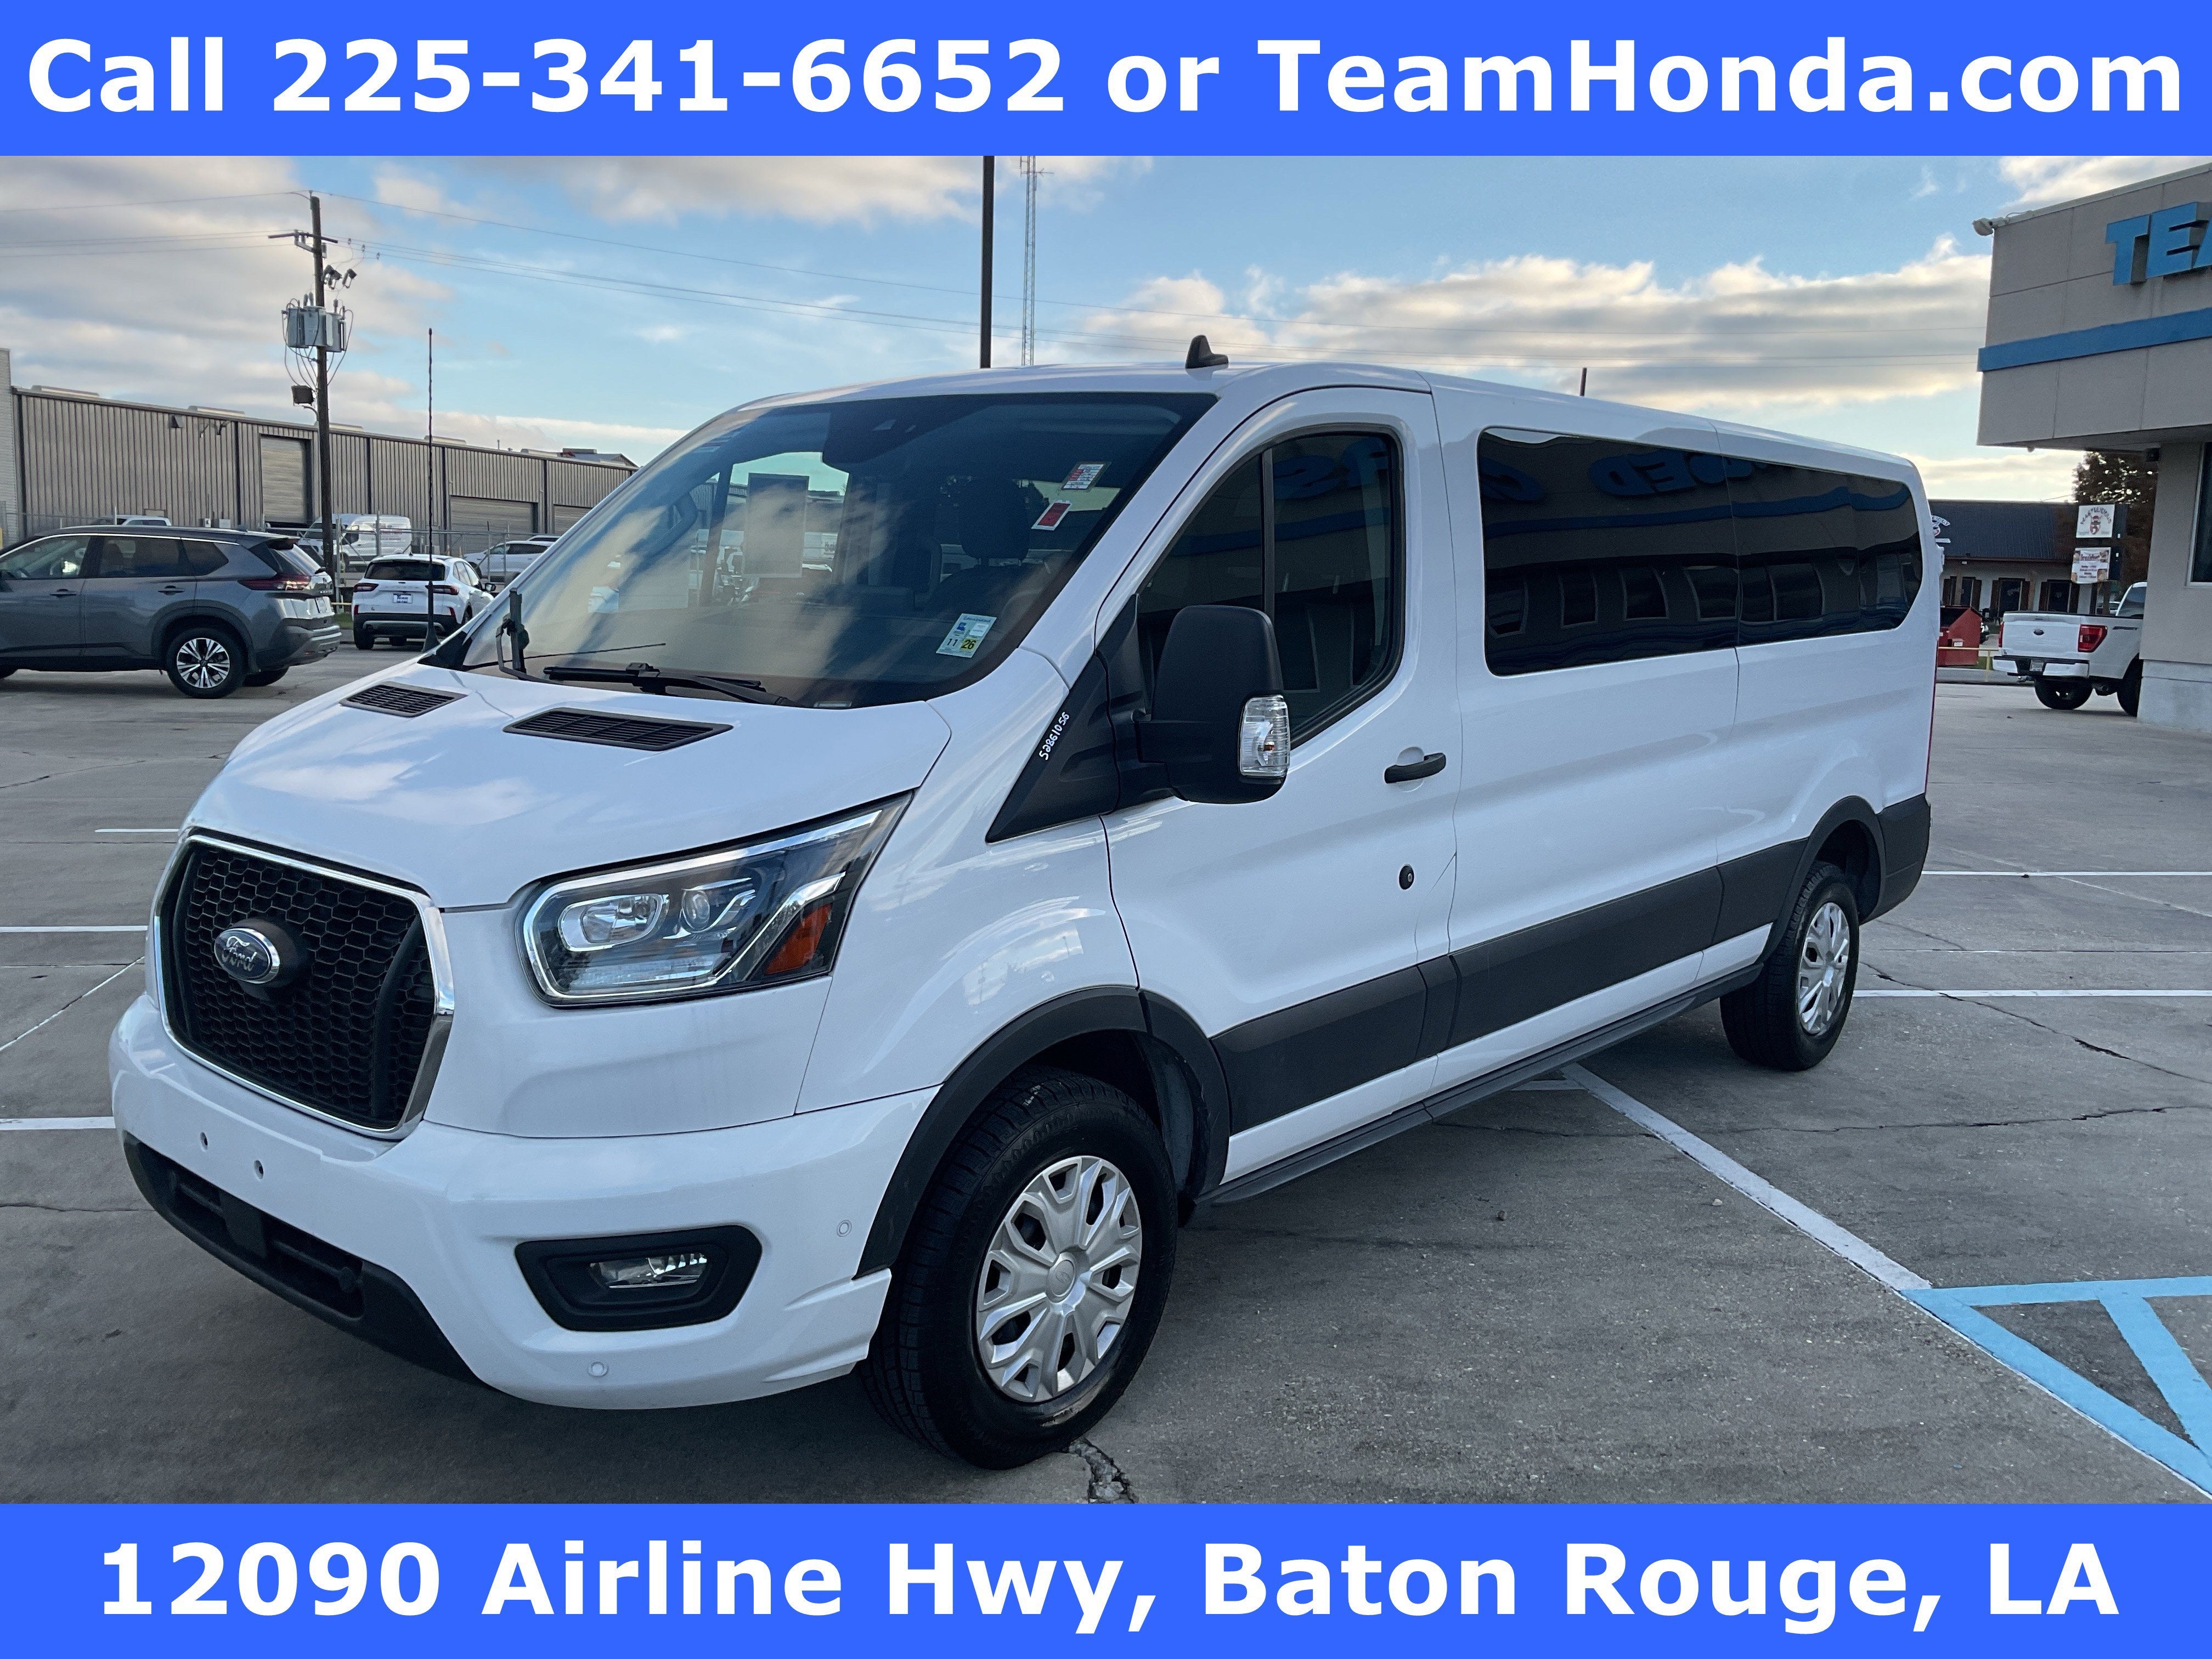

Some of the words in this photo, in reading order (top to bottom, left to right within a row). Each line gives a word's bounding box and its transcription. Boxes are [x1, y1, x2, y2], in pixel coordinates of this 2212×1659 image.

[947, 638, 958, 647] 11
[961, 639, 977, 650] 26
[222, 935, 258, 972] Ford
